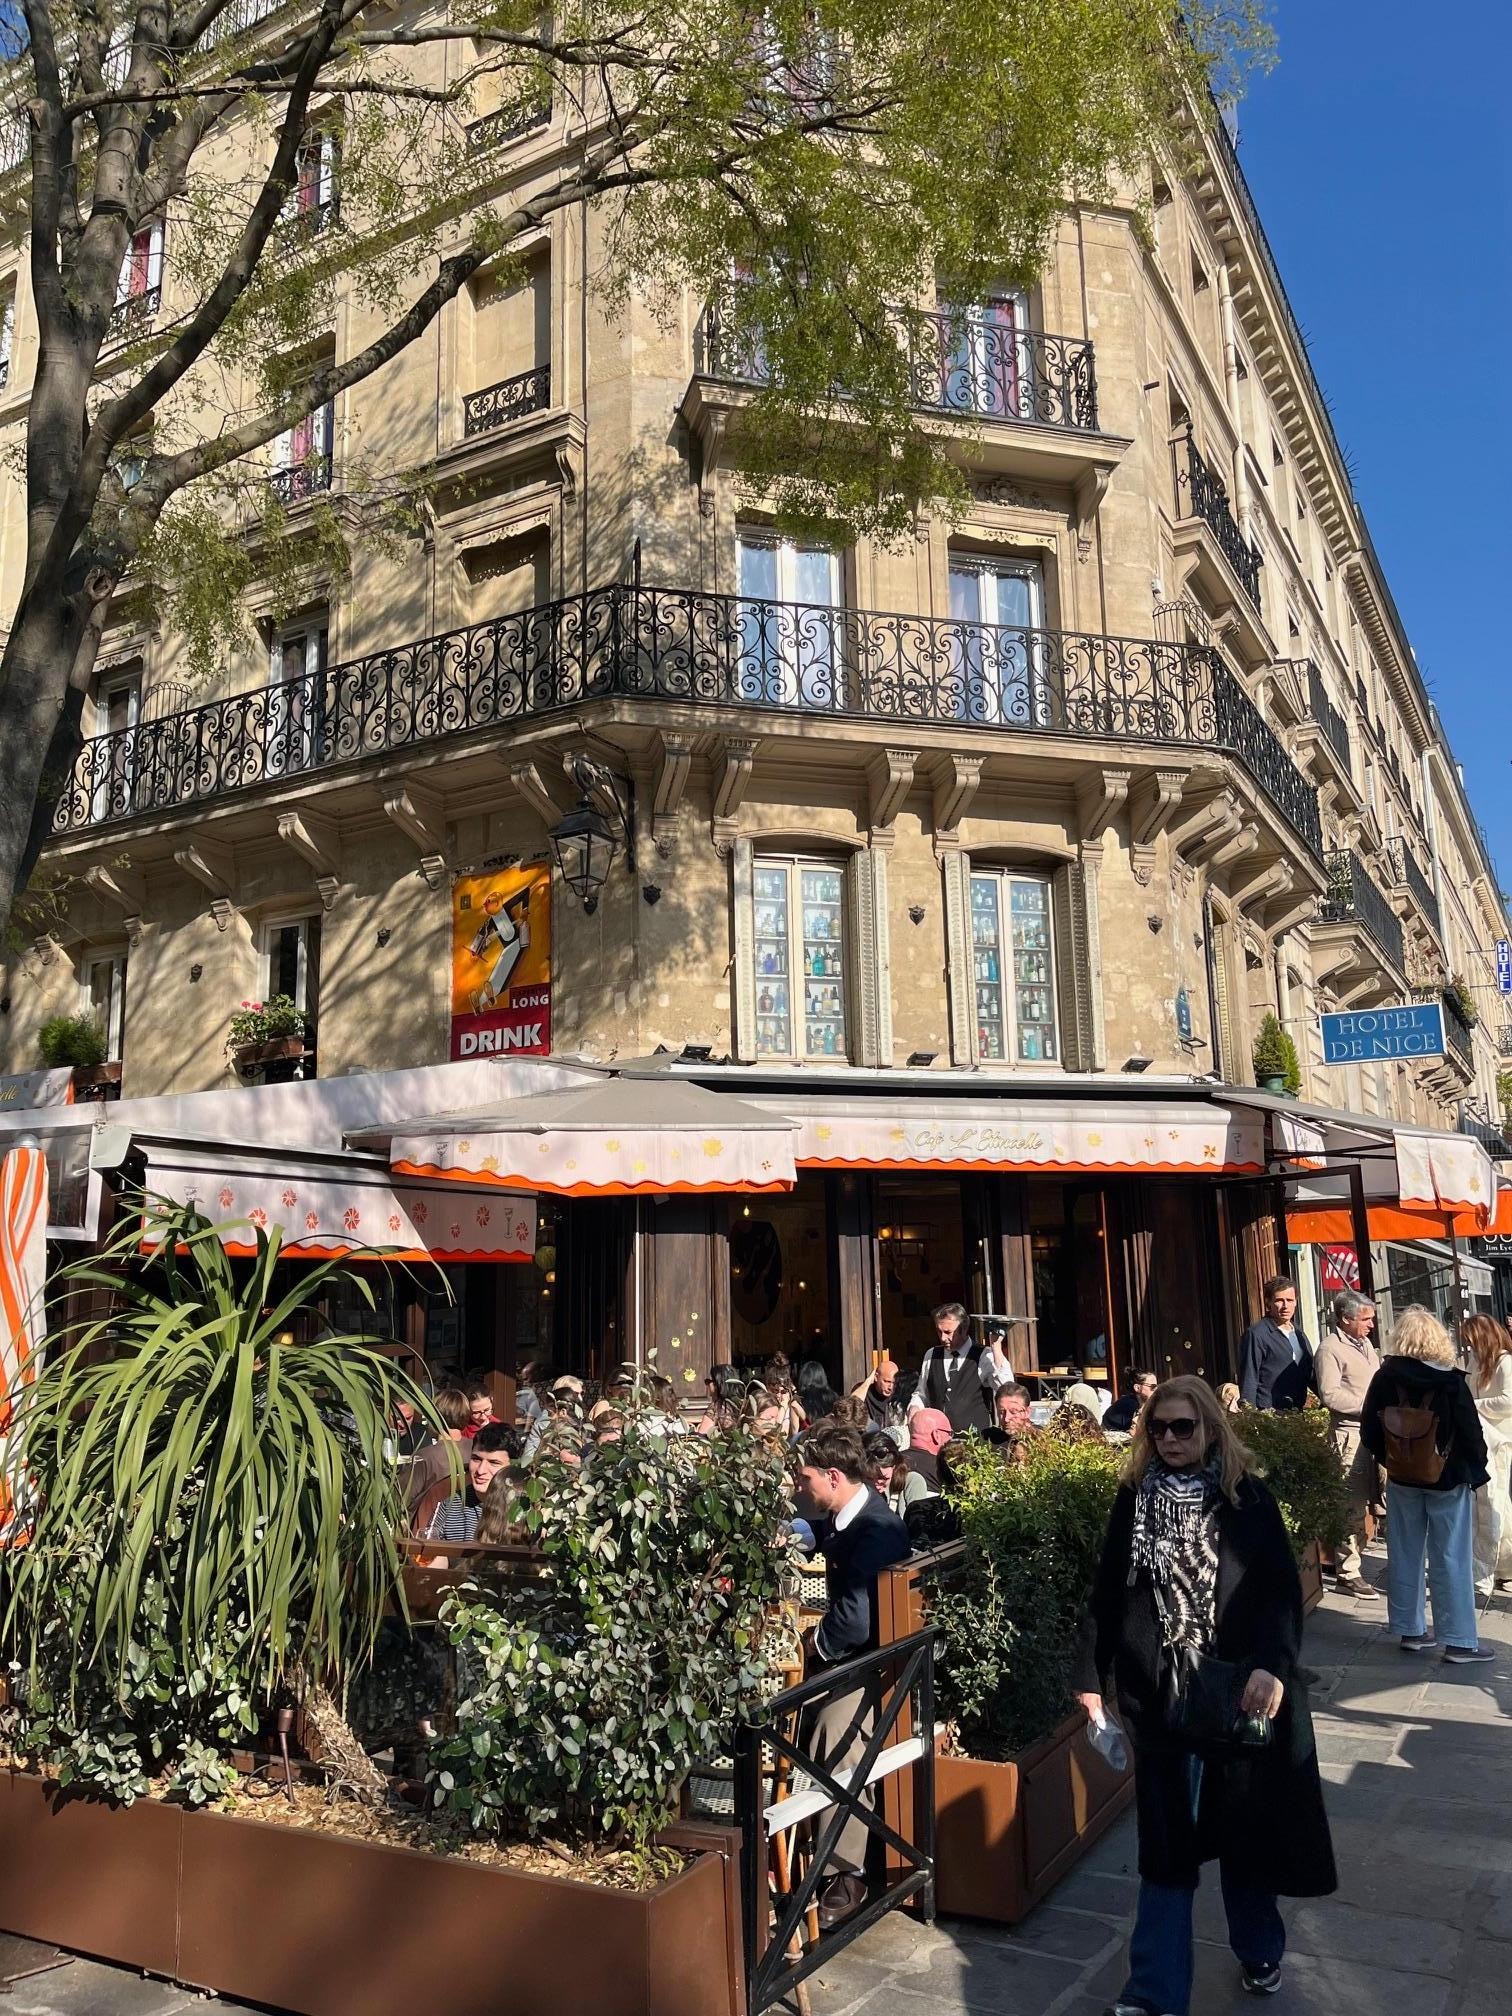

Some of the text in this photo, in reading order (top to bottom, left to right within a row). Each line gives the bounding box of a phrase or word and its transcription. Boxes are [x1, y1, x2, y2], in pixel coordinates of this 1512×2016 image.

[1497, 943, 1510, 991] HOTEL
[512, 993, 549, 1009] LONG
[1337, 1010, 1424, 1035] HOTEL
[460, 1023, 542, 1056] DRINK
[1331, 1033, 1437, 1059] DE NICE
